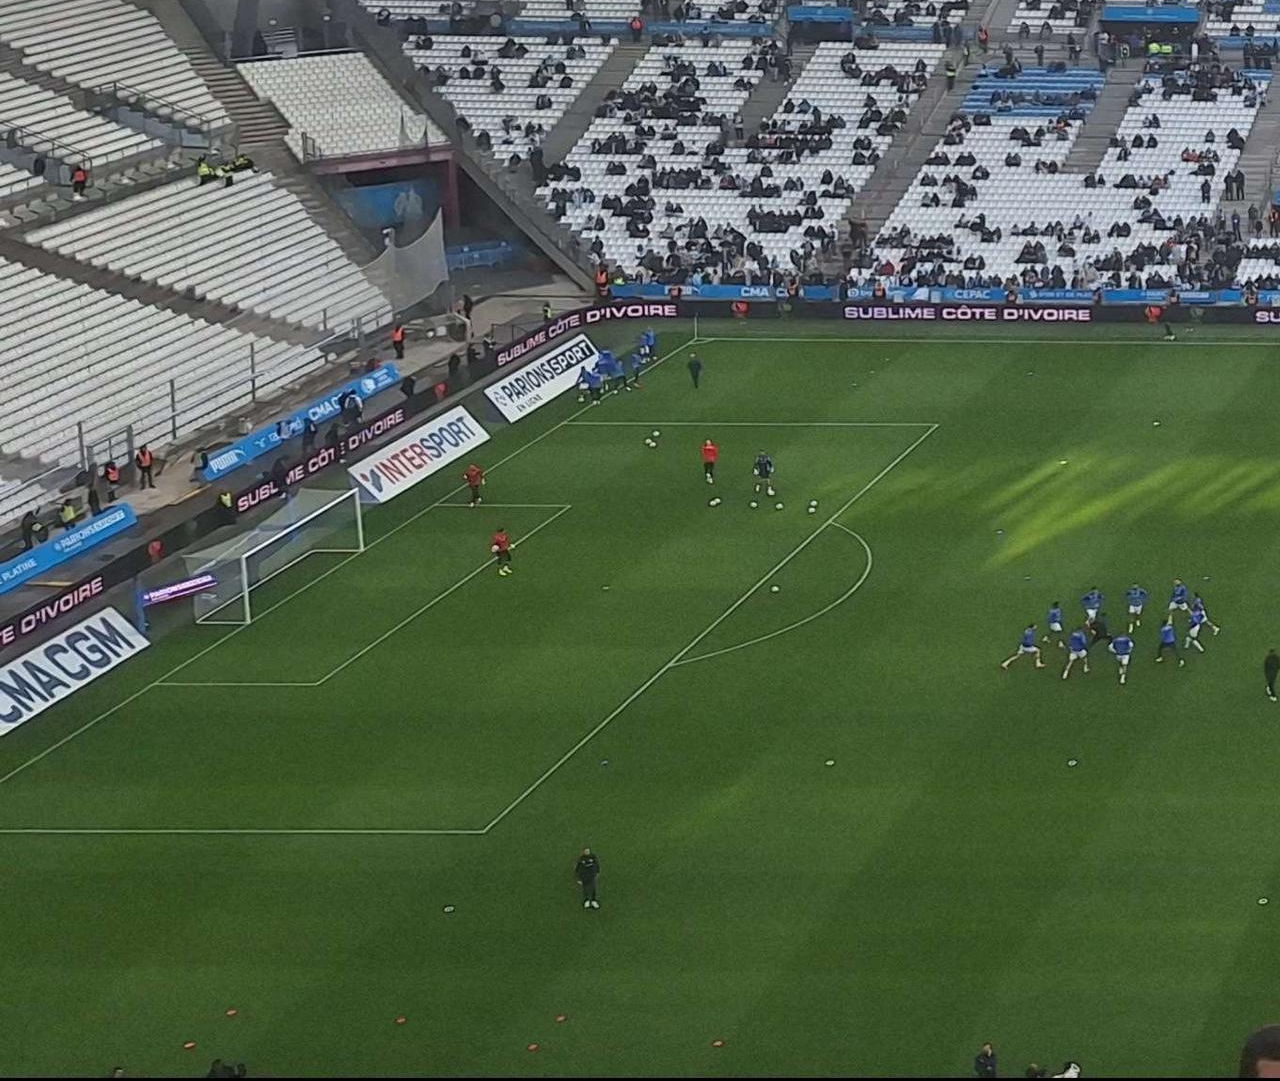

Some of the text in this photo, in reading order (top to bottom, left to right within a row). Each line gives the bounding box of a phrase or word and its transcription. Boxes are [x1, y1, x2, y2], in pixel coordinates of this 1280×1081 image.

[740, 287, 770, 297] CMA
[844, 304, 1091, 322] SUBLIME CÔTE D'IVOIRE
[954, 289, 992, 300] CEPAC
[497, 304, 678, 366] SUBLIME CÔTE D'IVOIRE
[237, 464, 305, 512] SUBLME
[348, 409, 404, 450] D'IVOIRE
[375, 416, 476, 486] INTERSPORT
[21, 576, 104, 635] D'IVOIRE
